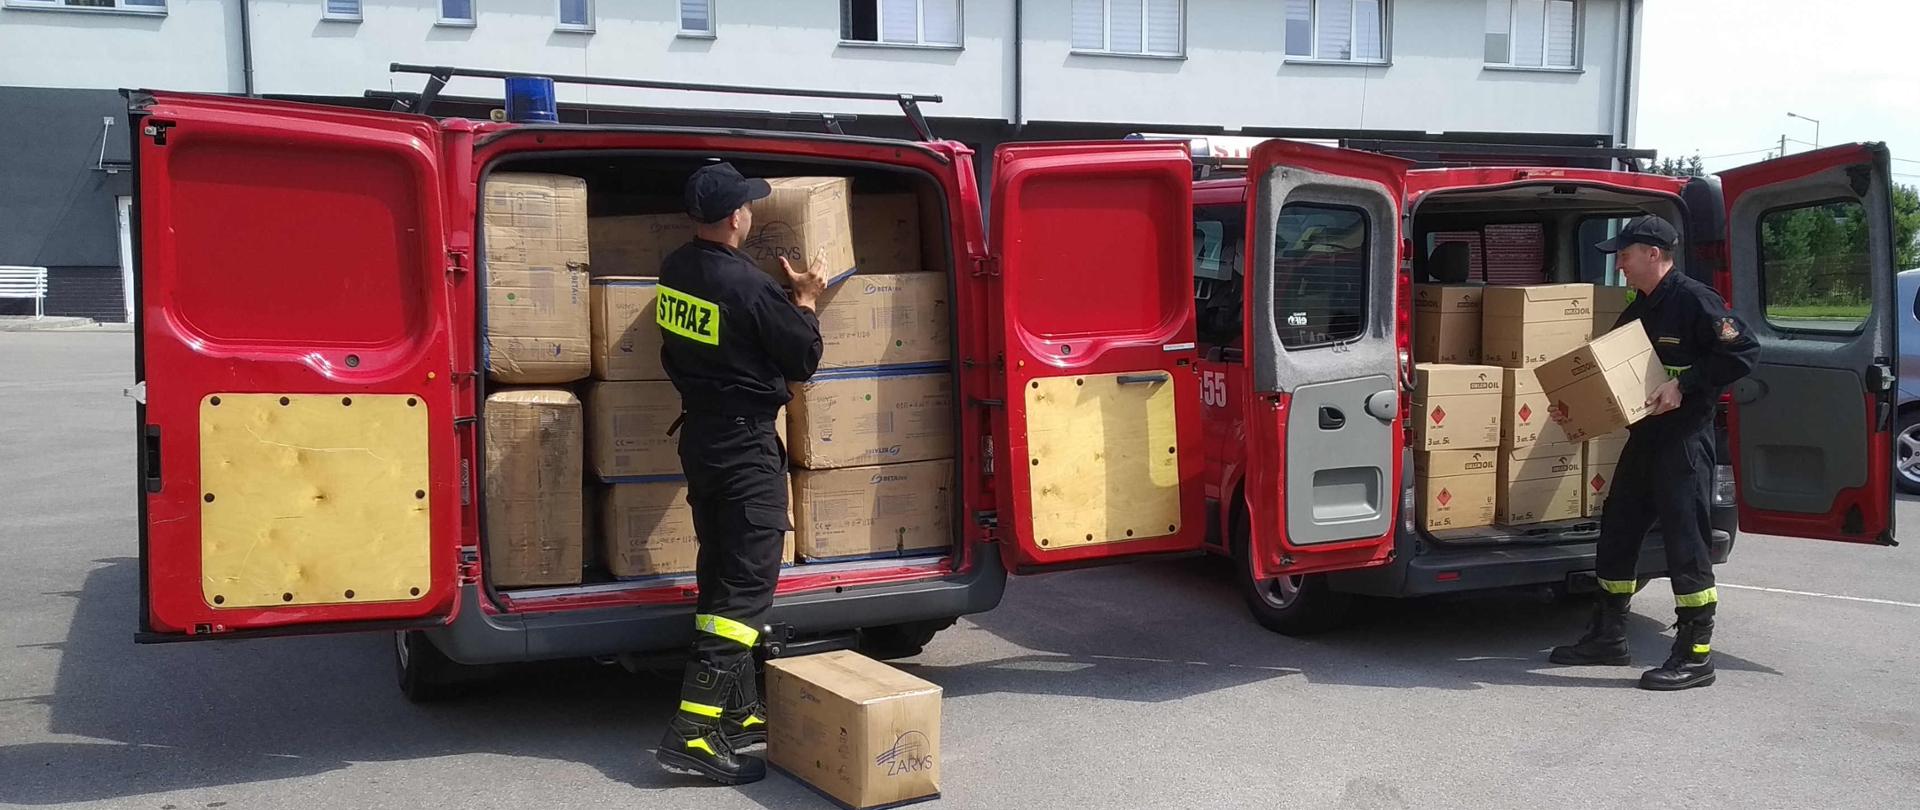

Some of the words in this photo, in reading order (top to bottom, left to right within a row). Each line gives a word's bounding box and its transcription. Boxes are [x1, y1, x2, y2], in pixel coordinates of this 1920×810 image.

[755, 246, 800, 260] ZARYS
[1482, 461, 1493, 469] OIL
[887, 755, 933, 776] ZARYS
